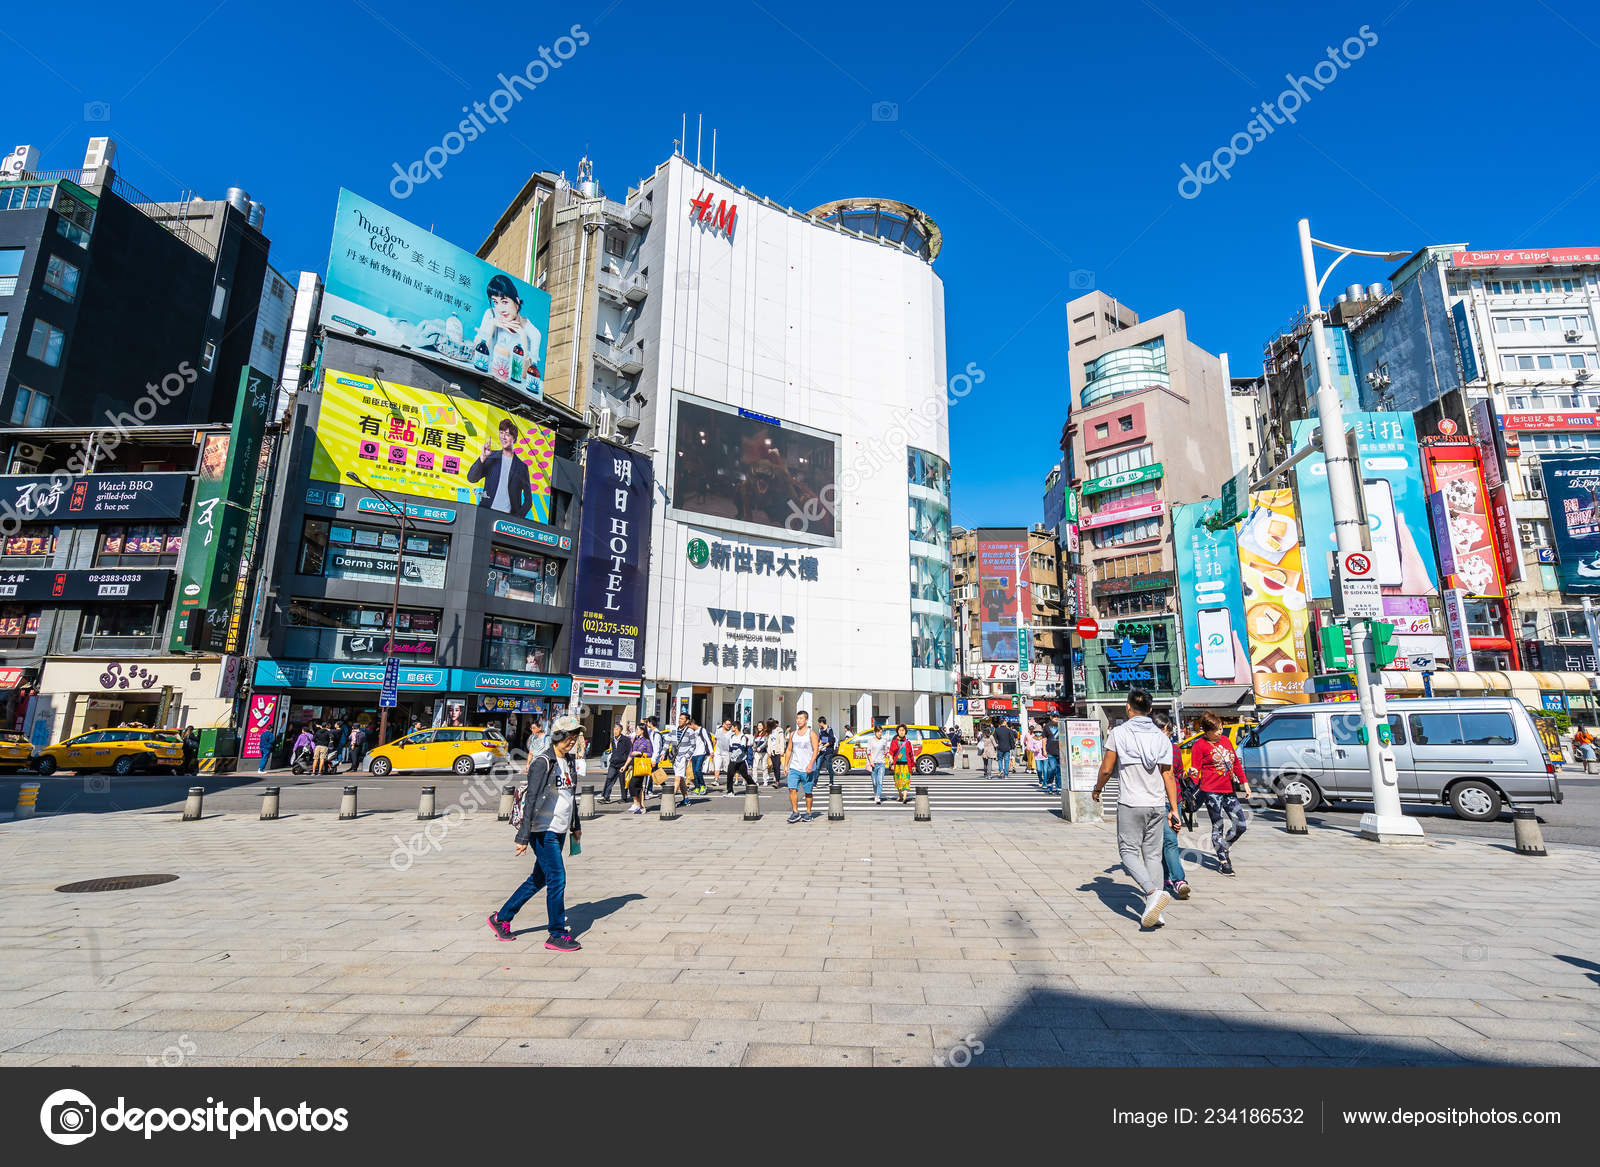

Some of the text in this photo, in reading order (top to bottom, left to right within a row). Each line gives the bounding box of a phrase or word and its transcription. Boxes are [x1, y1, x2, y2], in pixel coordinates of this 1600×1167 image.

[689, 188, 737, 236] H&M
[369, 235, 399, 260] belle
[1472, 252, 1500, 262] Diary
[1520, 251, 1549, 261] Taipei
[98, 481, 153, 491] Watch BBQ
[96, 492, 137, 501] grilled-food
[117, 503, 130, 511] pot
[366, 500, 418, 516] watsons
[500, 523, 535, 538] watsons
[604, 457, 632, 611] 明日 HOTEL
[335, 556, 373, 569] Derma
[710, 541, 819, 582] 新世界大樓
[583, 618, 639, 637] (02)2375-5500
[100, 661, 158, 689] Sassy
[341, 669, 400, 682] watsos
[1108, 668, 1151, 681] adidas
[481, 676, 520, 688] watsons
